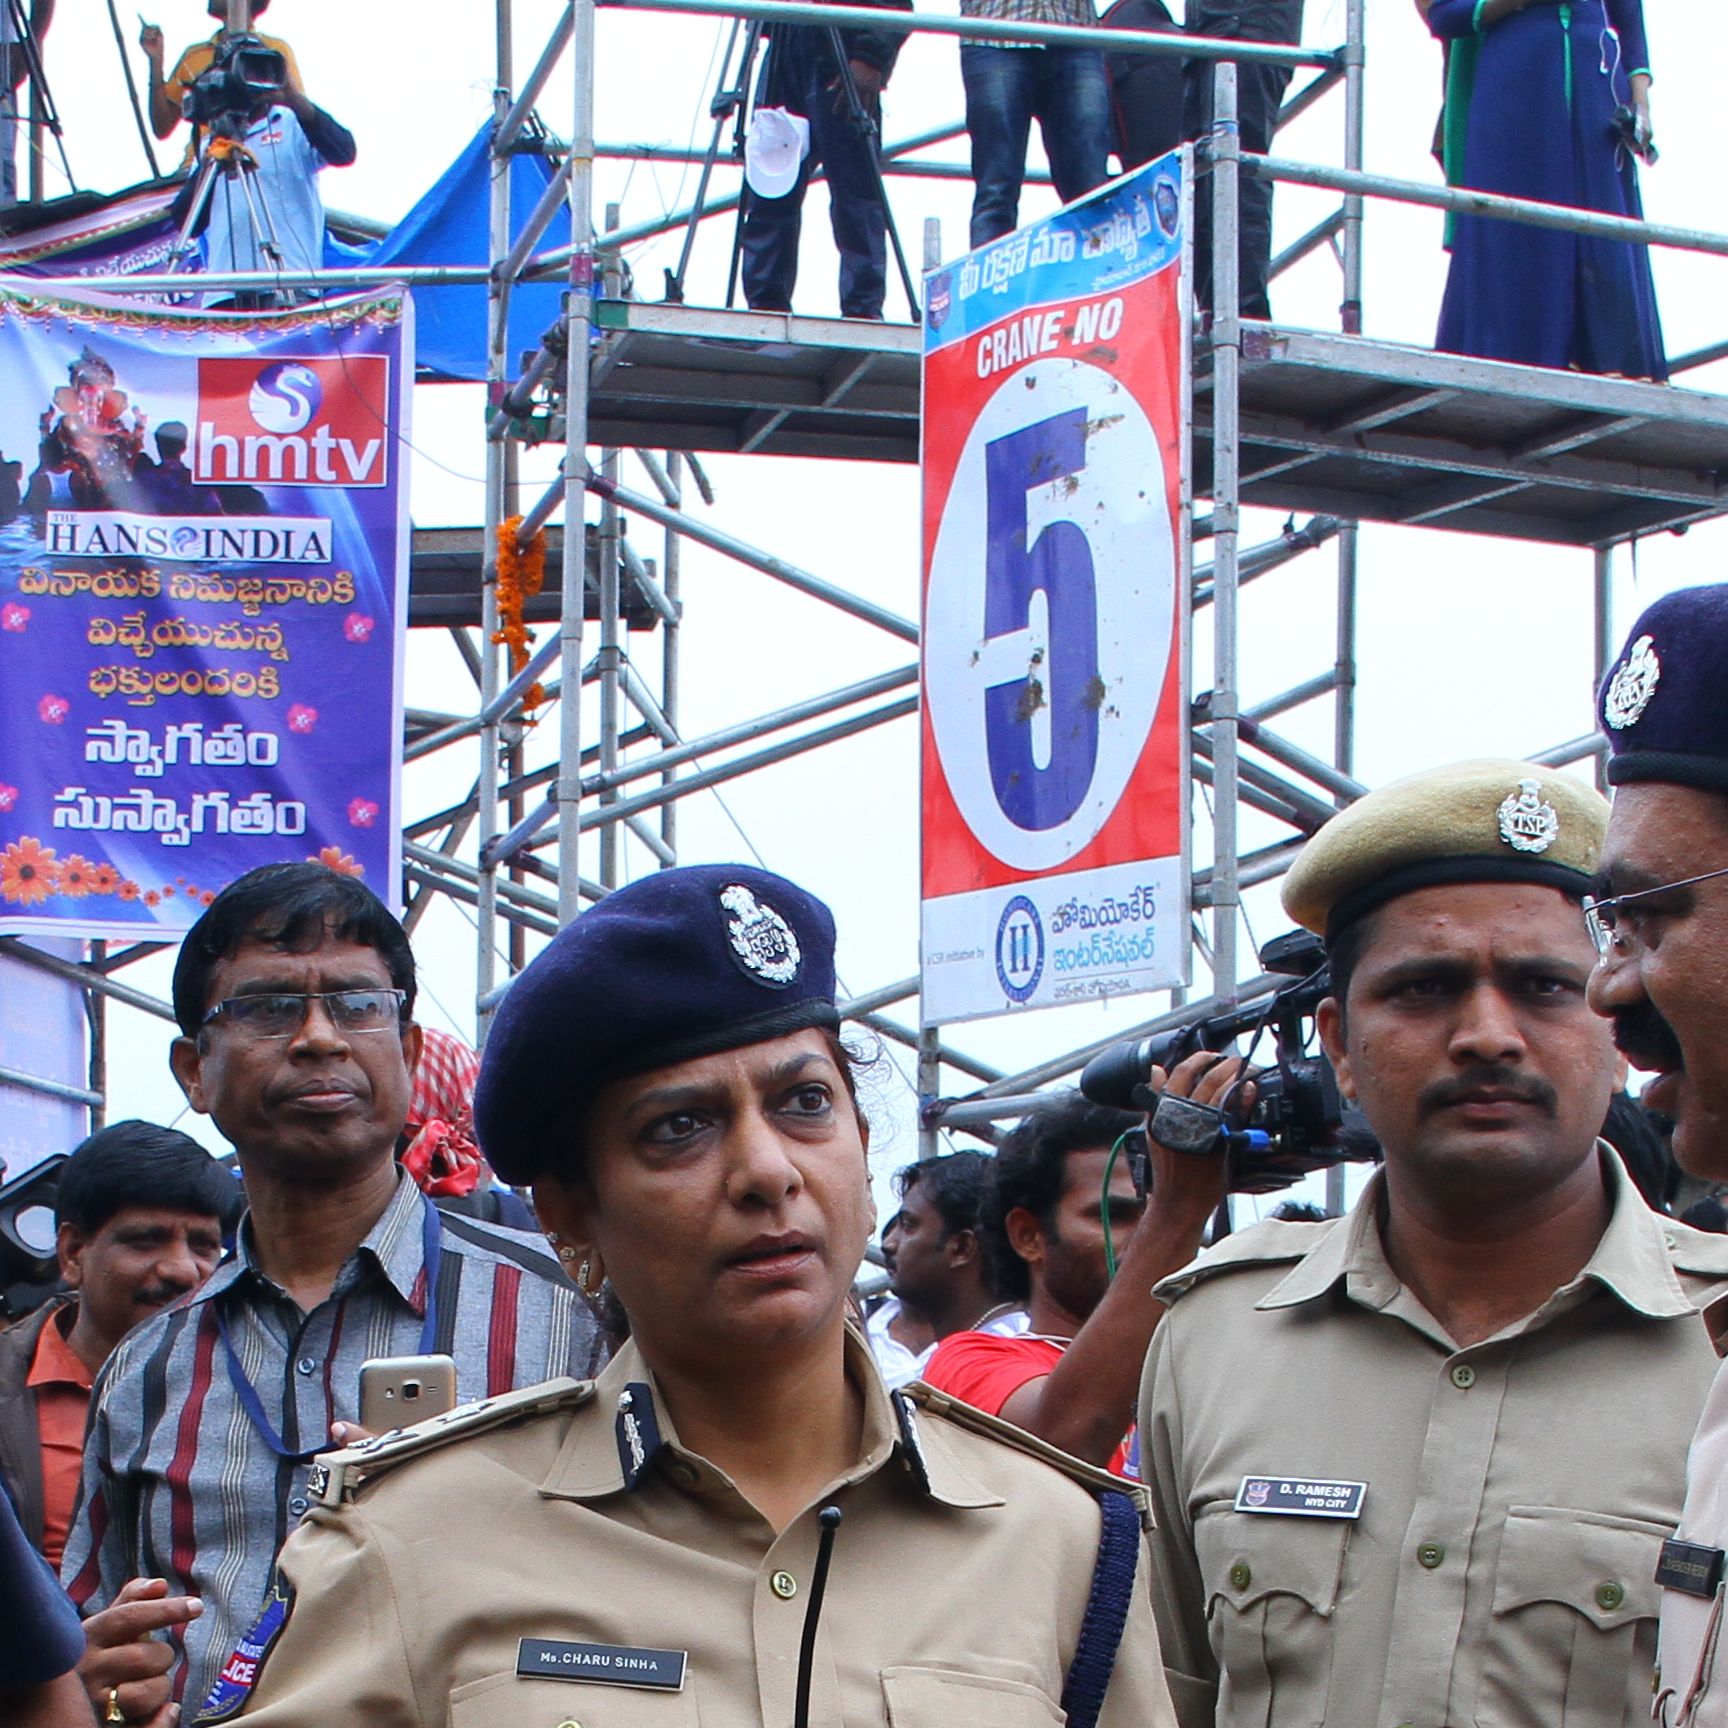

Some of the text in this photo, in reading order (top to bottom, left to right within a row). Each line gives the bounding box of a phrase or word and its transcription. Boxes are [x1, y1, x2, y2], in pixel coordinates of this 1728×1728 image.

[977, 298, 1123, 379] CRANE NO
[200, 422, 381, 481] hmtv
[48, 524, 329, 560] HANS INDIA
[53, 513, 78, 524] THE
[20, 567, 357, 616] వినాయక నిమజ్జనానికి
[86, 610, 290, 662] విచ్చేయుచున్న
[984, 406, 1100, 833] 5
[88, 664, 281, 706] భక్తులందరికి
[85, 719, 278, 777] స్వాగతం
[53, 787, 306, 846] సుస్వాగతం
[1280, 1484, 1352, 1498] D. RAMESH
[1305, 1498, 1348, 1509] HYD CITY
[615, 1656, 658, 1671] SINHA
